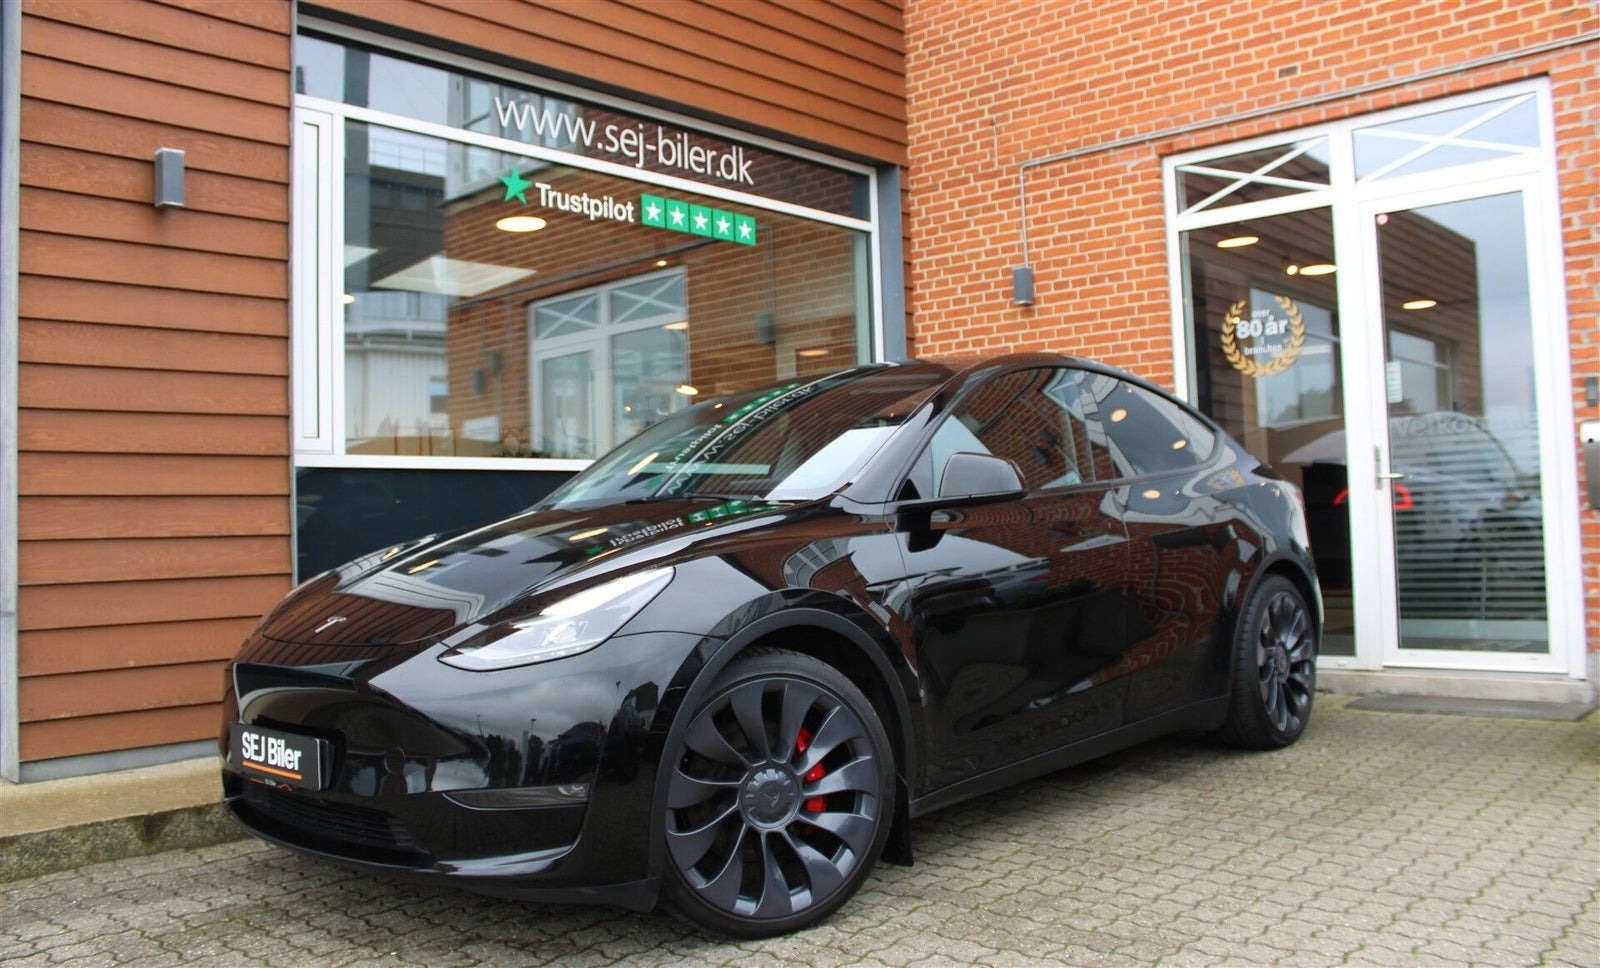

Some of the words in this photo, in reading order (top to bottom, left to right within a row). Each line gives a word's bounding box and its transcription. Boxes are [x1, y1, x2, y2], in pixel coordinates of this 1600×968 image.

[495, 96, 754, 185] www.sej-biler.dk
[535, 182, 635, 223] Trustpilot
[1236, 320, 1263, 339] 80
[1265, 315, 1288, 335] år
[241, 731, 265, 762] SEJ
[267, 736, 302, 771] Biler
